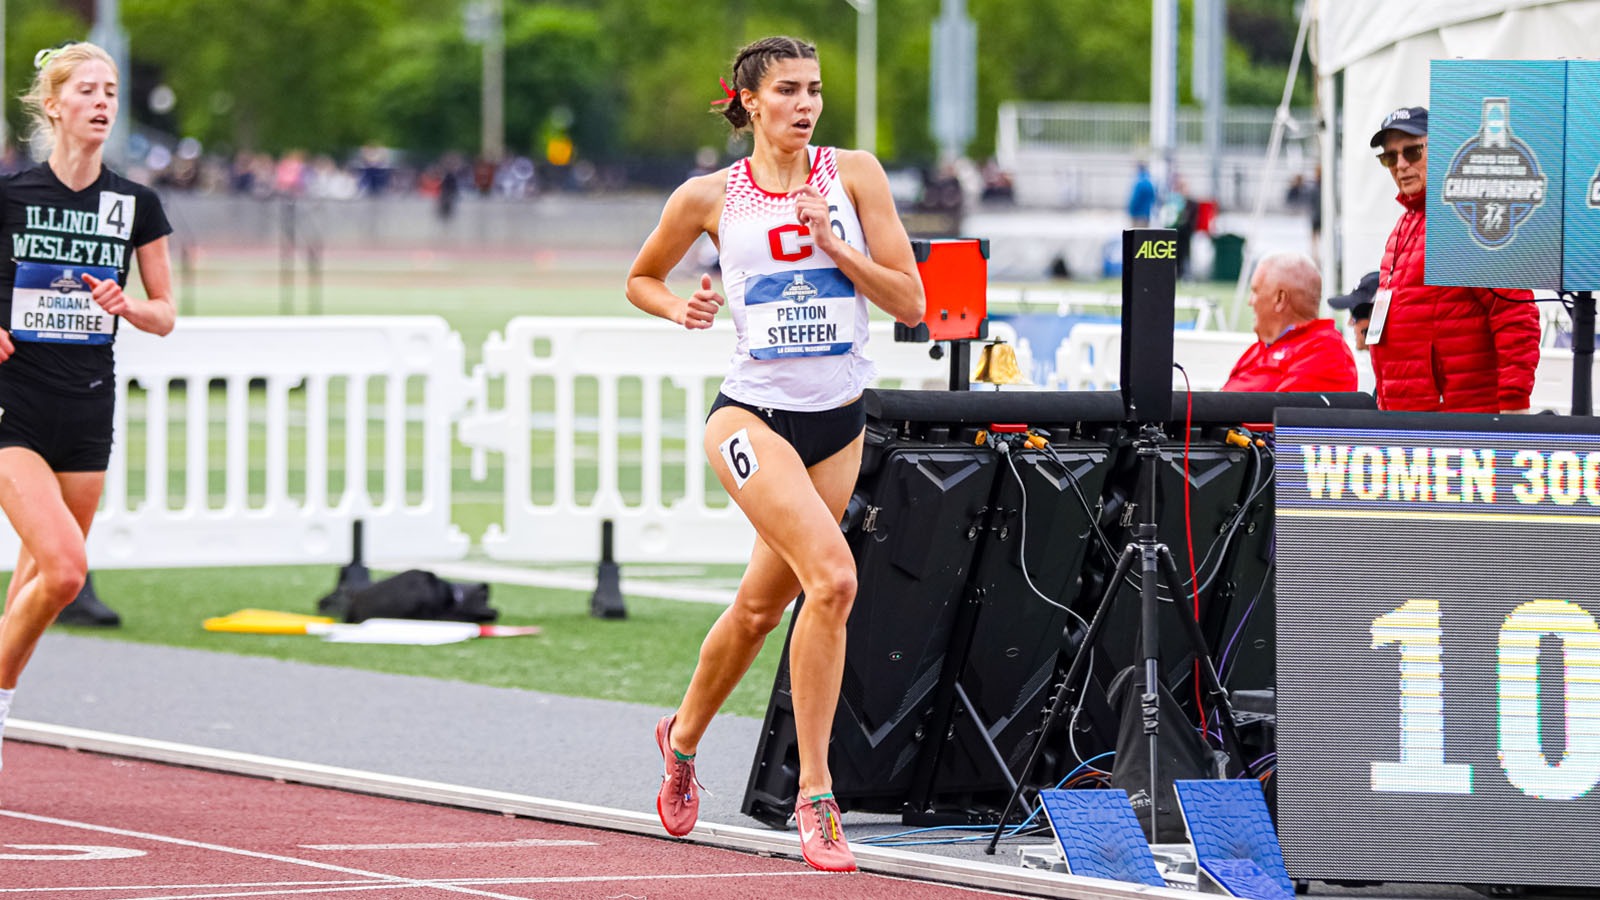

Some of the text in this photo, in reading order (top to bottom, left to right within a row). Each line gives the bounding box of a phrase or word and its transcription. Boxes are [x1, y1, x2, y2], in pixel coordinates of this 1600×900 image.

[25, 205, 100, 236] ILLINO
[106, 200, 126, 234] 4
[12, 233, 125, 268] WESLEYAN
[767, 223, 815, 263] C
[1135, 240, 1177, 259] ALGE
[37, 295, 91, 310] ADRIANA
[777, 305, 827, 322] PEYTON
[23, 311, 103, 331] CRABTREE
[767, 323, 837, 345] STEFFEN
[729, 437, 751, 479] 6
[1302, 446, 1496, 503] WOMEN
